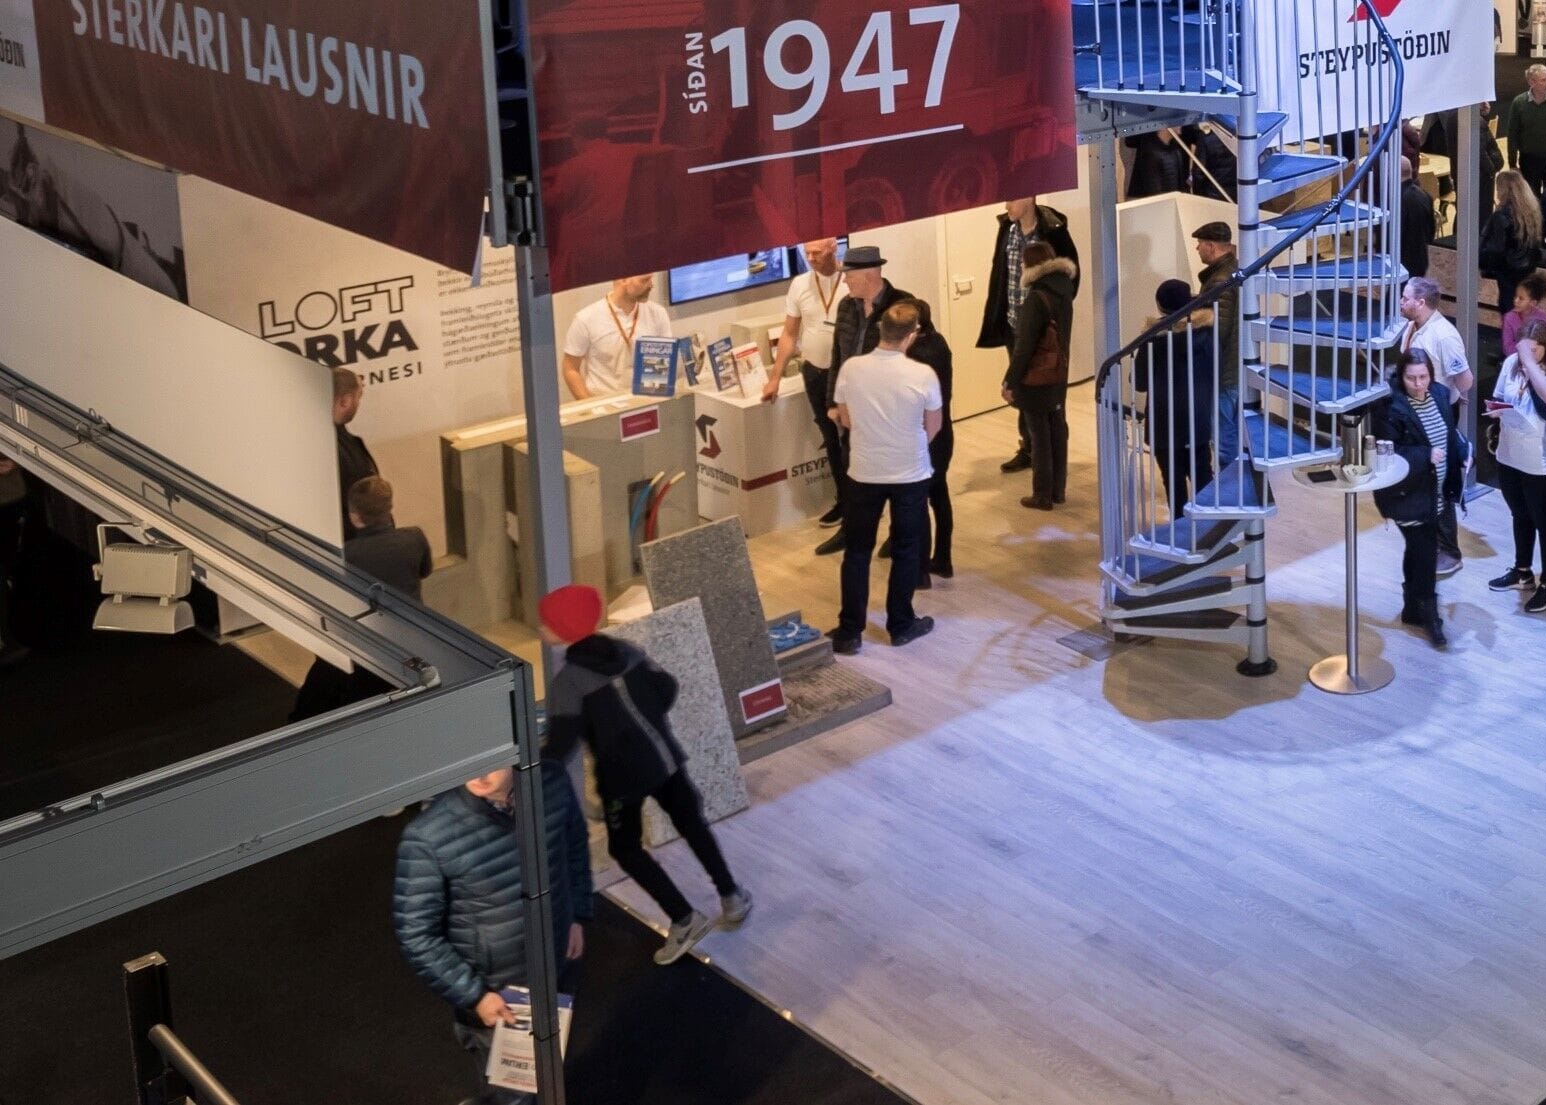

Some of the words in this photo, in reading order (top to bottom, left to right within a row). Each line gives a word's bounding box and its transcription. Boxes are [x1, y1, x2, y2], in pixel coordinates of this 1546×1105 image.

[241, 16, 431, 130] LAUSNIR
[687, 31, 709, 114] SÍÐAN
[710, 3, 960, 132] 1947
[1299, 30, 1451, 79] STEYPUSÖÐIN
[258, 275, 414, 339] LOFT
